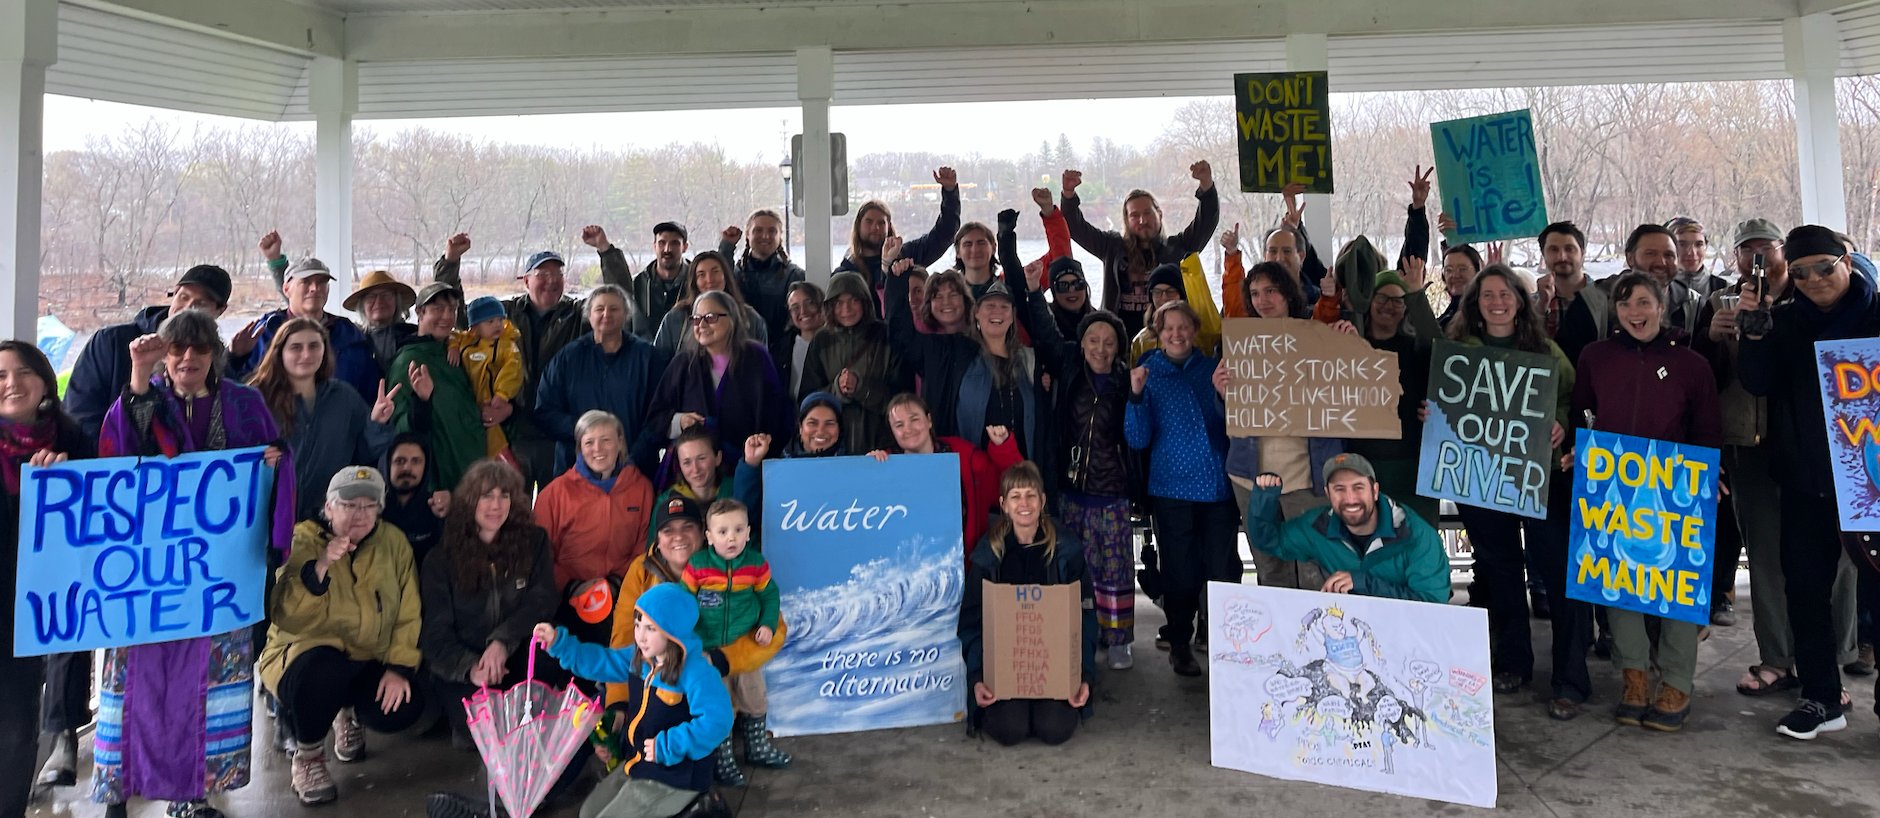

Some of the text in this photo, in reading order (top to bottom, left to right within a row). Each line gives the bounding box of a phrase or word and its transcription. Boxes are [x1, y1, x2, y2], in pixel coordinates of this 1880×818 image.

[1248, 74, 1323, 107] DON'T
[1238, 108, 1327, 143] WASTE
[1442, 116, 1534, 163] WATER
[1257, 145, 1328, 187] ME!
[1468, 162, 1491, 190] is
[1226, 334, 1298, 356] WATER
[1226, 357, 1388, 383] HOLDS STORIES
[1439, 354, 1551, 418] SAVE
[1225, 384, 1392, 406] HOLDS LIVELIHOOD
[1226, 407, 1358, 432] HOLDS LIFE
[1457, 413, 1530, 454] OUR
[1431, 441, 1546, 513] RIVER
[1587, 447, 1708, 496] DON'T
[31, 451, 265, 552] RESPECT
[780, 498, 907, 532] Water
[1578, 498, 1704, 549] WASTE
[93, 537, 223, 592] OUR
[1577, 554, 1699, 606] MAINE
[26, 582, 250, 645] WATER
[1015, 612, 1044, 623] PFOA
[1016, 624, 1042, 635] PFOS
[821, 646, 940, 671] there is no
[1016, 636, 1044, 647] PFNA
[819, 673, 954, 698] alternative
[1017, 685, 1045, 696] PFAS
